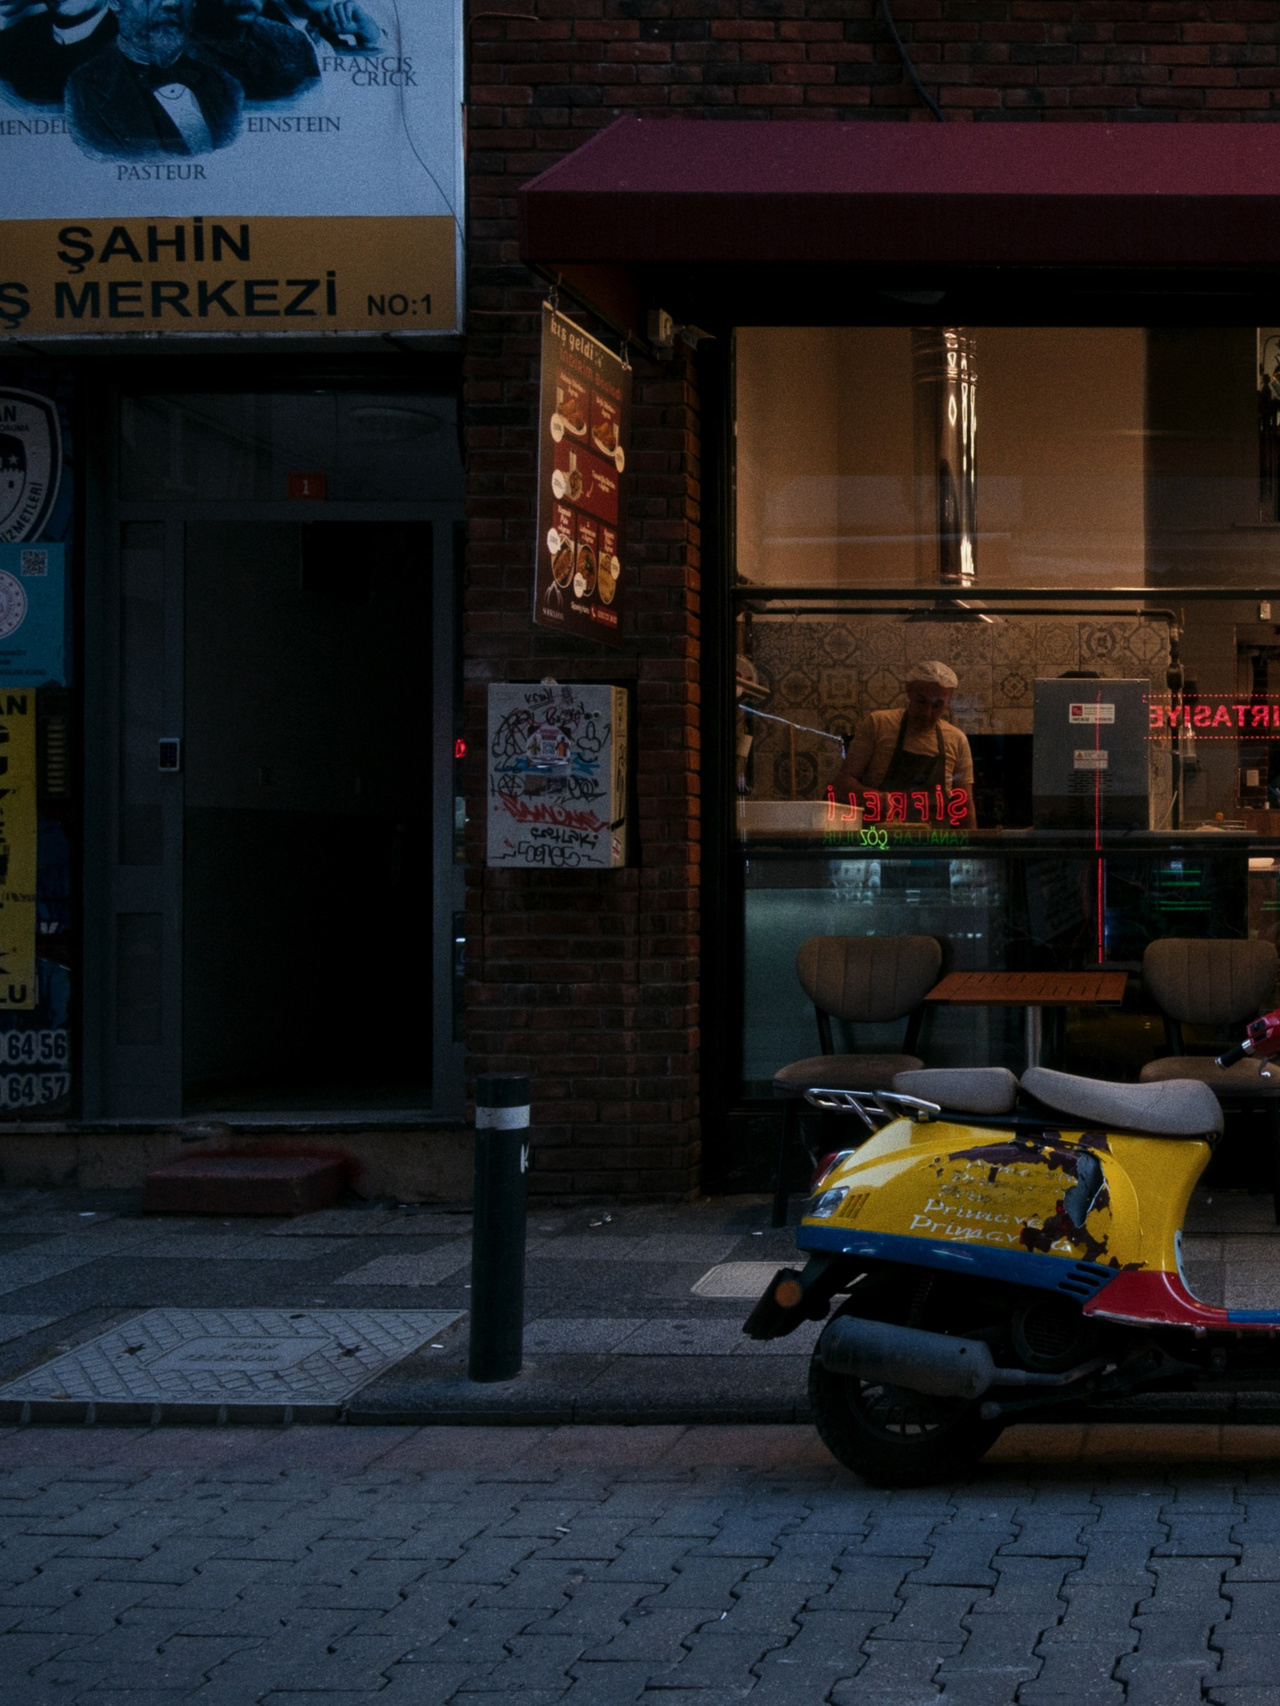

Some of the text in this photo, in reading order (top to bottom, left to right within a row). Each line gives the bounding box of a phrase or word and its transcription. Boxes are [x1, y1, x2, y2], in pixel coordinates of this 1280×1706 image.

[322, 56, 413, 73] FRANCIS
[352, 70, 418, 87] CRICK
[247, 116, 341, 133] EINSTEIN
[117, 164, 206, 181] PASTEUR
[57, 216, 250, 274] ŞAHİN
[55, 271, 338, 319] MERKEZİ
[367, 294, 432, 316] NO:1
[8, 1033, 66, 1060] 64 56
[8, 1076, 66, 1102] 64 57
